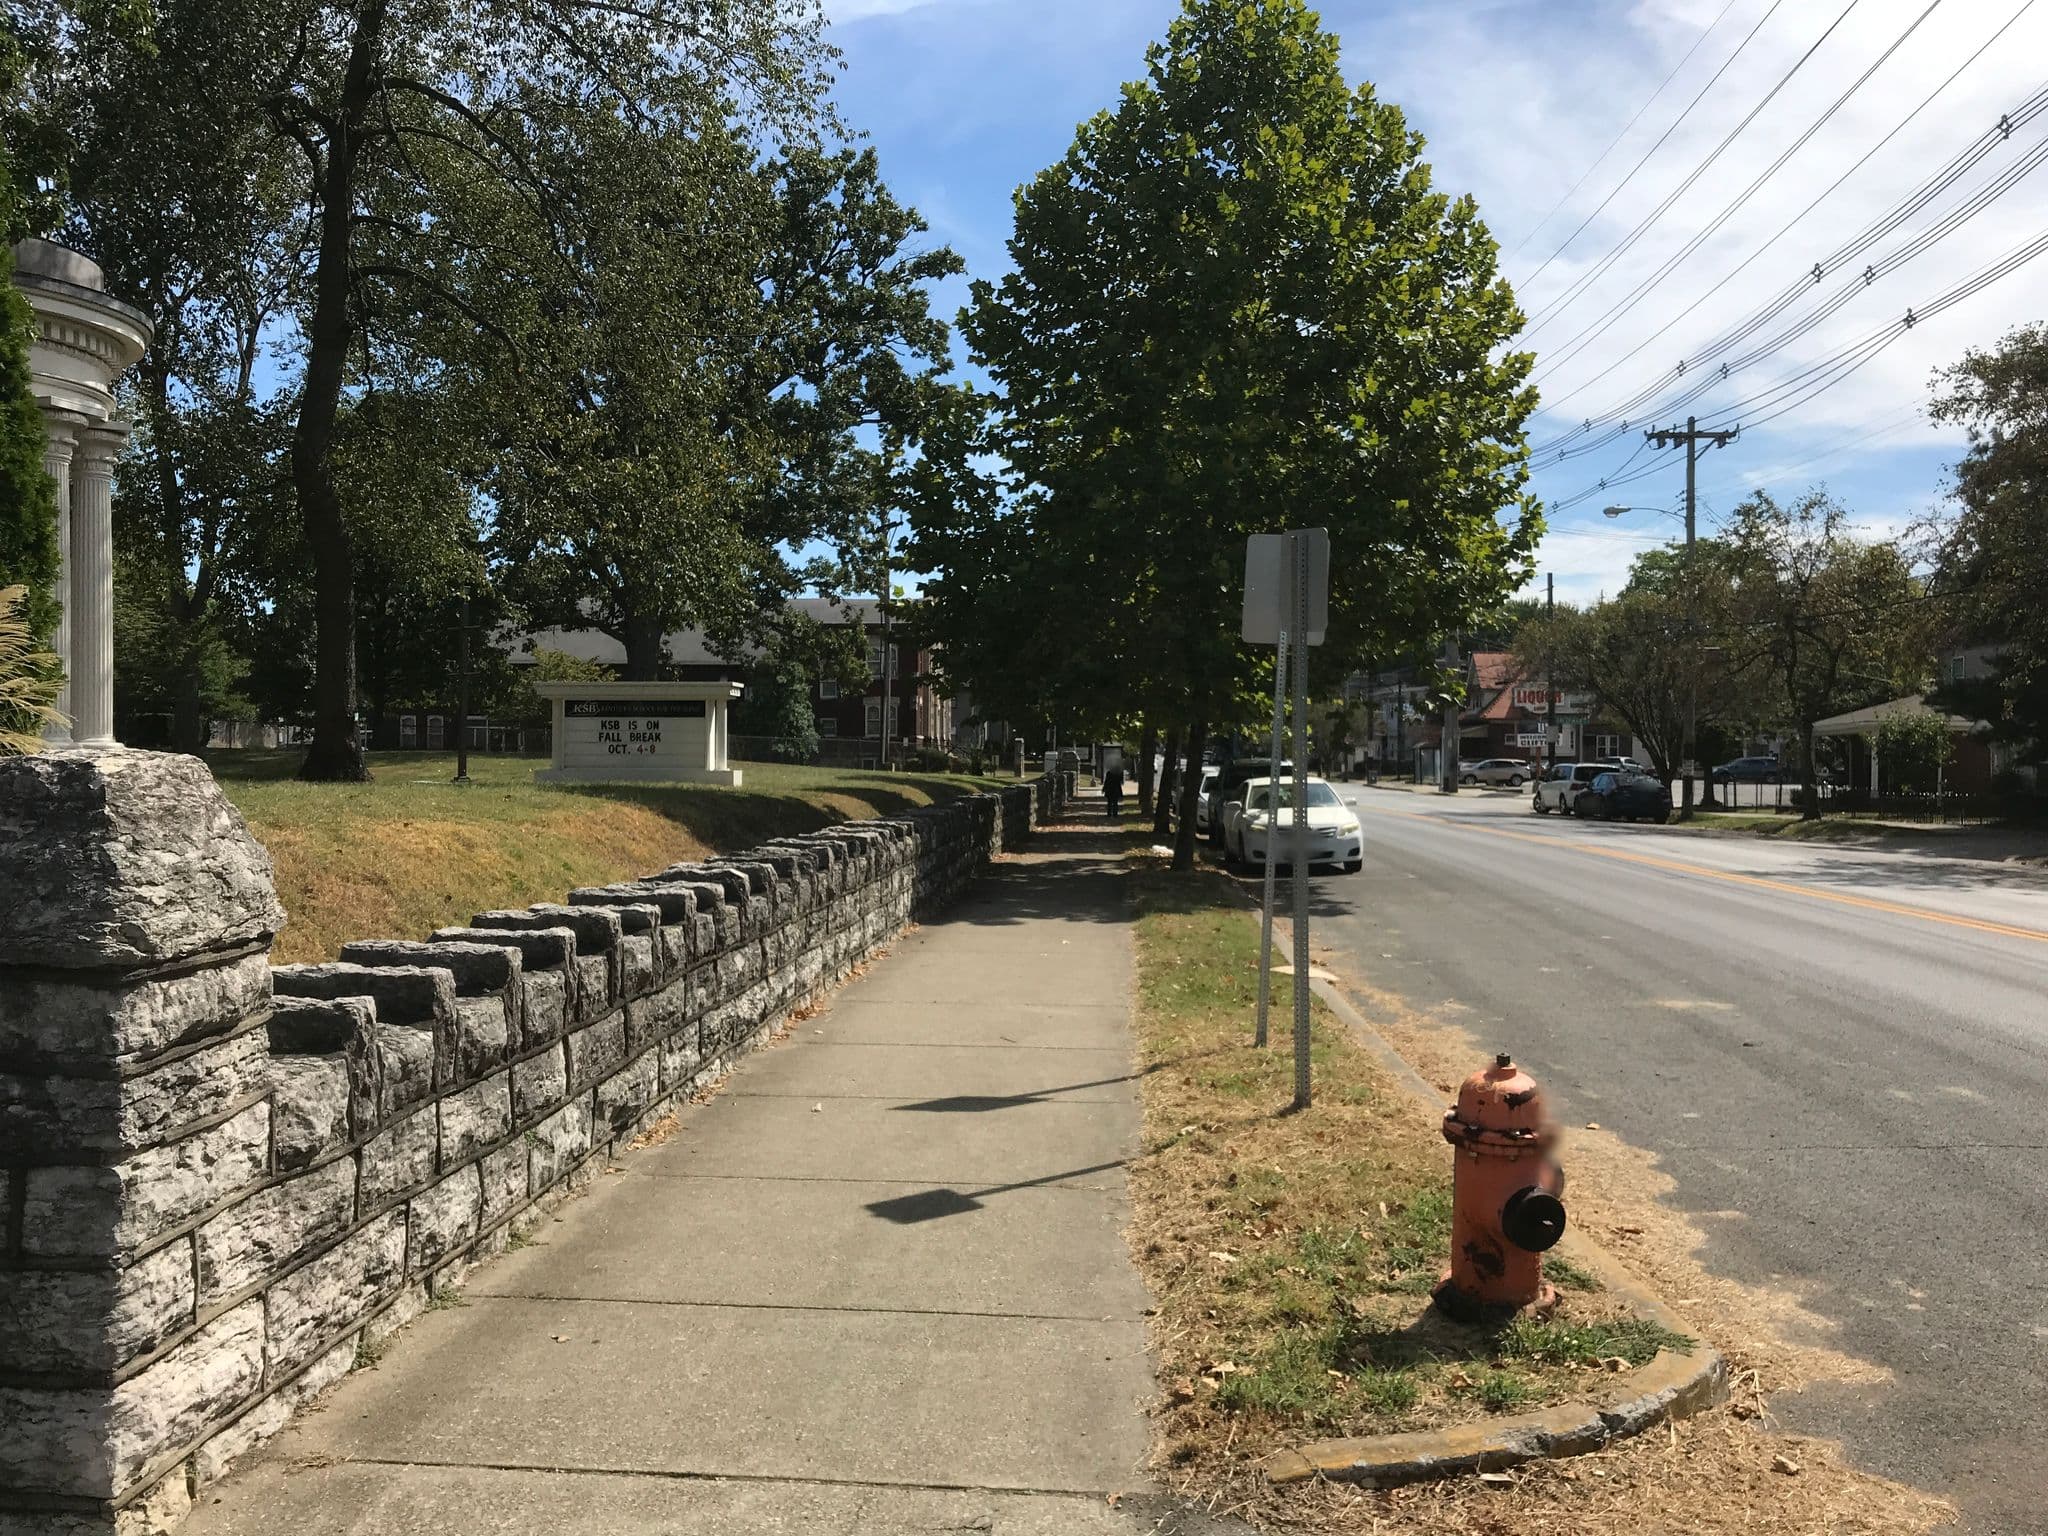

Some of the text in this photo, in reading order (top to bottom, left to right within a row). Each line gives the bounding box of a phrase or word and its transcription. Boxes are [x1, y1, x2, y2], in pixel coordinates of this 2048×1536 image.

[574, 703, 597, 713] KSB
[600, 720, 660, 730] KSB IS ON
[599, 732, 662, 742] FALL BREAK
[608, 744, 656, 755] OCT. 4-8
